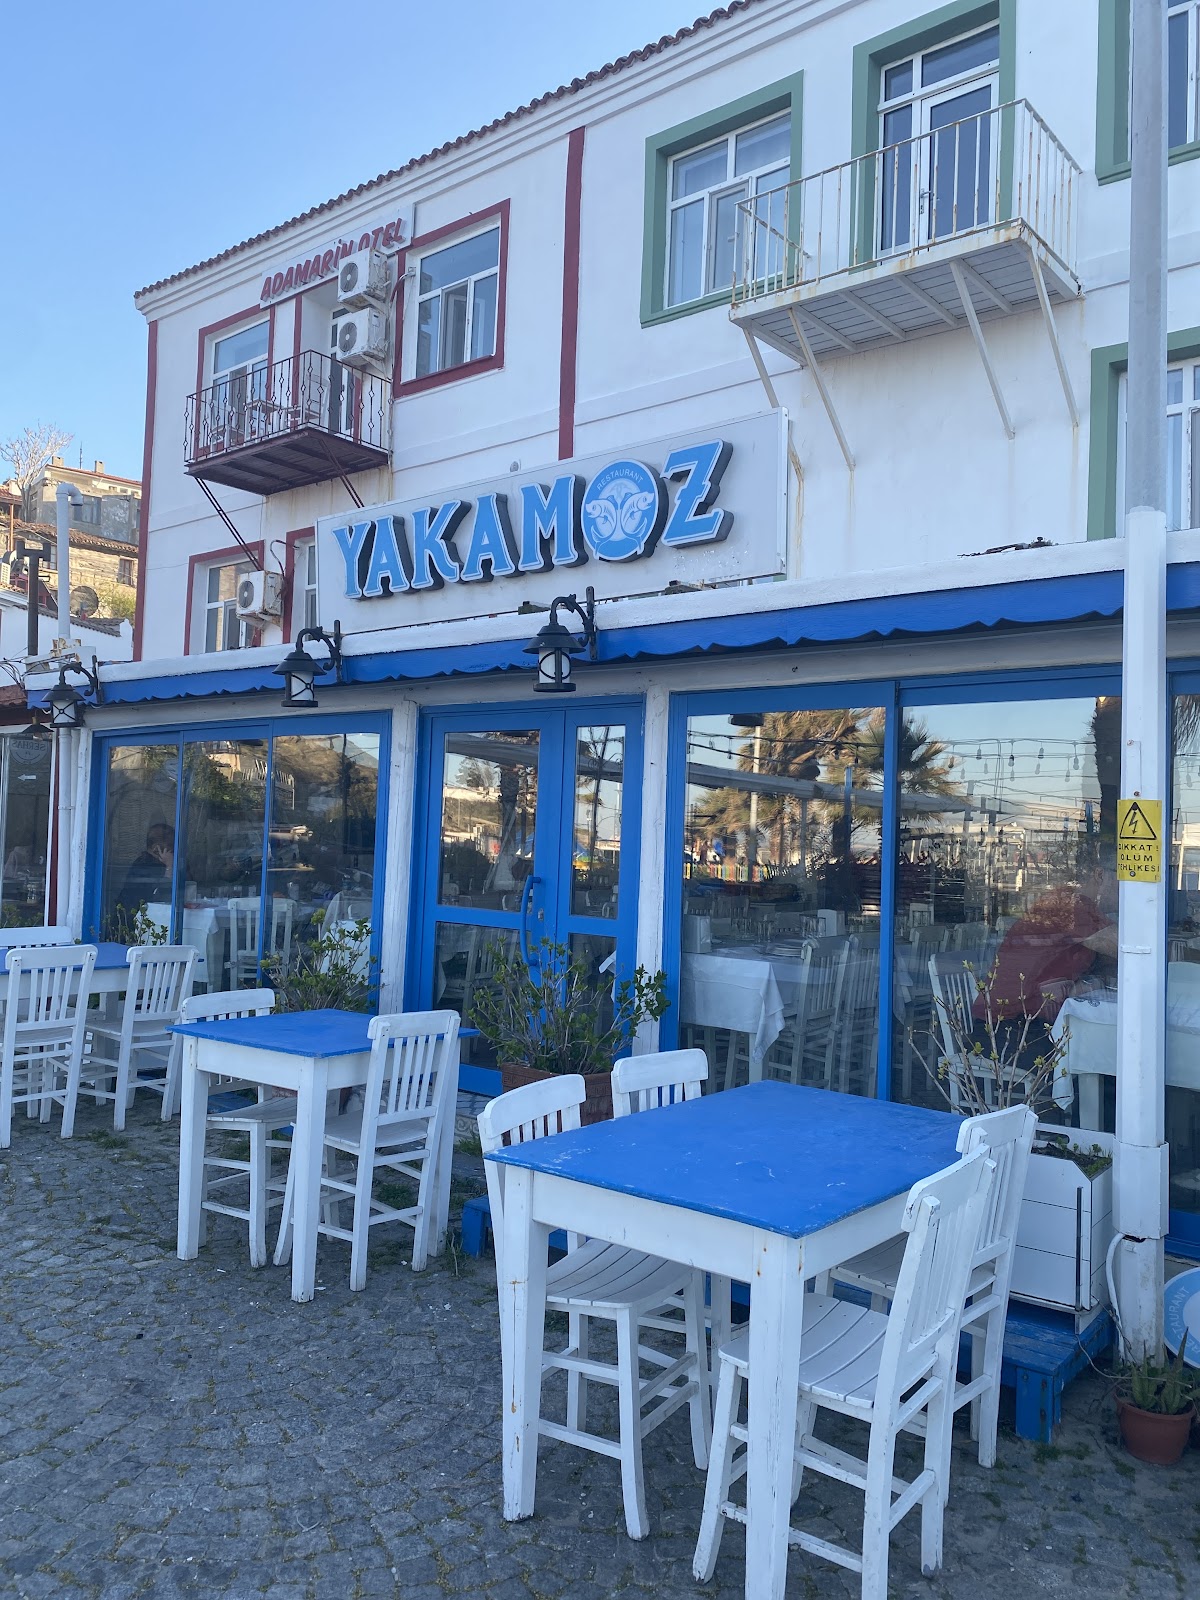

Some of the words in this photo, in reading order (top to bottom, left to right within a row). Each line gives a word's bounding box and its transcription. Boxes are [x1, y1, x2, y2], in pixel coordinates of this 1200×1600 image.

[358, 217, 404, 250] OTEL
[596, 468, 644, 491] RESTAURANT
[332, 438, 732, 600] YAKAMOZ
